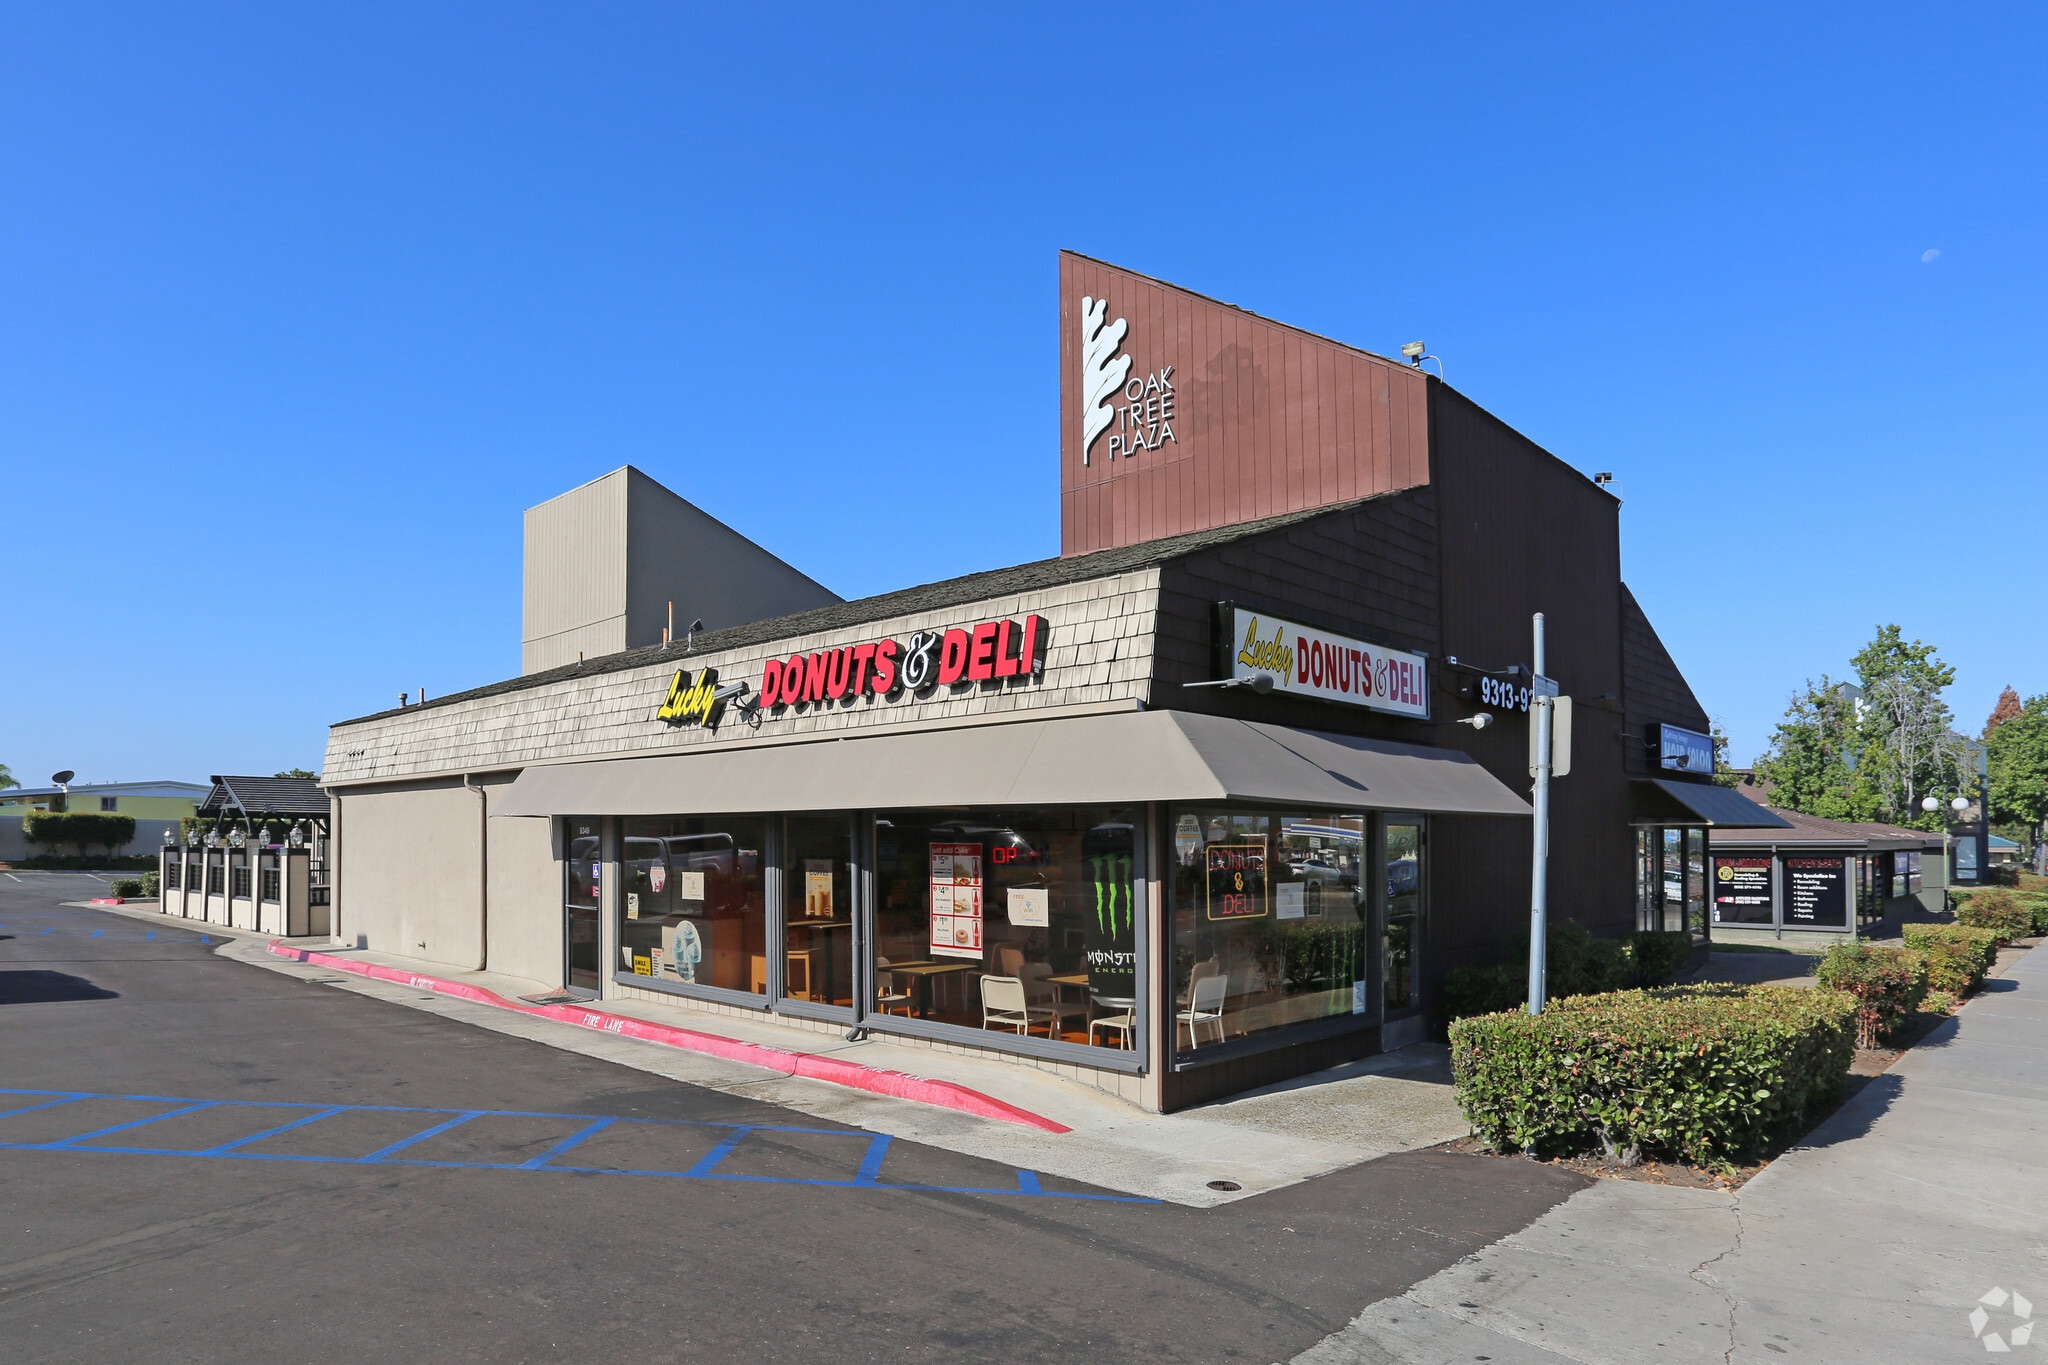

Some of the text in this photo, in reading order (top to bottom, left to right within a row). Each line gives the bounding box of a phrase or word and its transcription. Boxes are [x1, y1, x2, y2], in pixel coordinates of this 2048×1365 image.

[1125, 366, 1175, 402] OAK
[1117, 392, 1174, 430] TREE
[1109, 421, 1177, 460] PLAZA
[657, 614, 1044, 726] Lucky DONUTS & DELI
[1238, 616, 1423, 706] Lucky DONUTS & DELI
[1482, 677, 1534, 713] 9313-9
[1210, 850, 1265, 871] DONUTS
[1235, 872, 1244, 891] &
[1222, 894, 1255, 914] DELI
[1087, 949, 1136, 966] MONST
[582, 1014, 624, 1032] FIRE LANE
